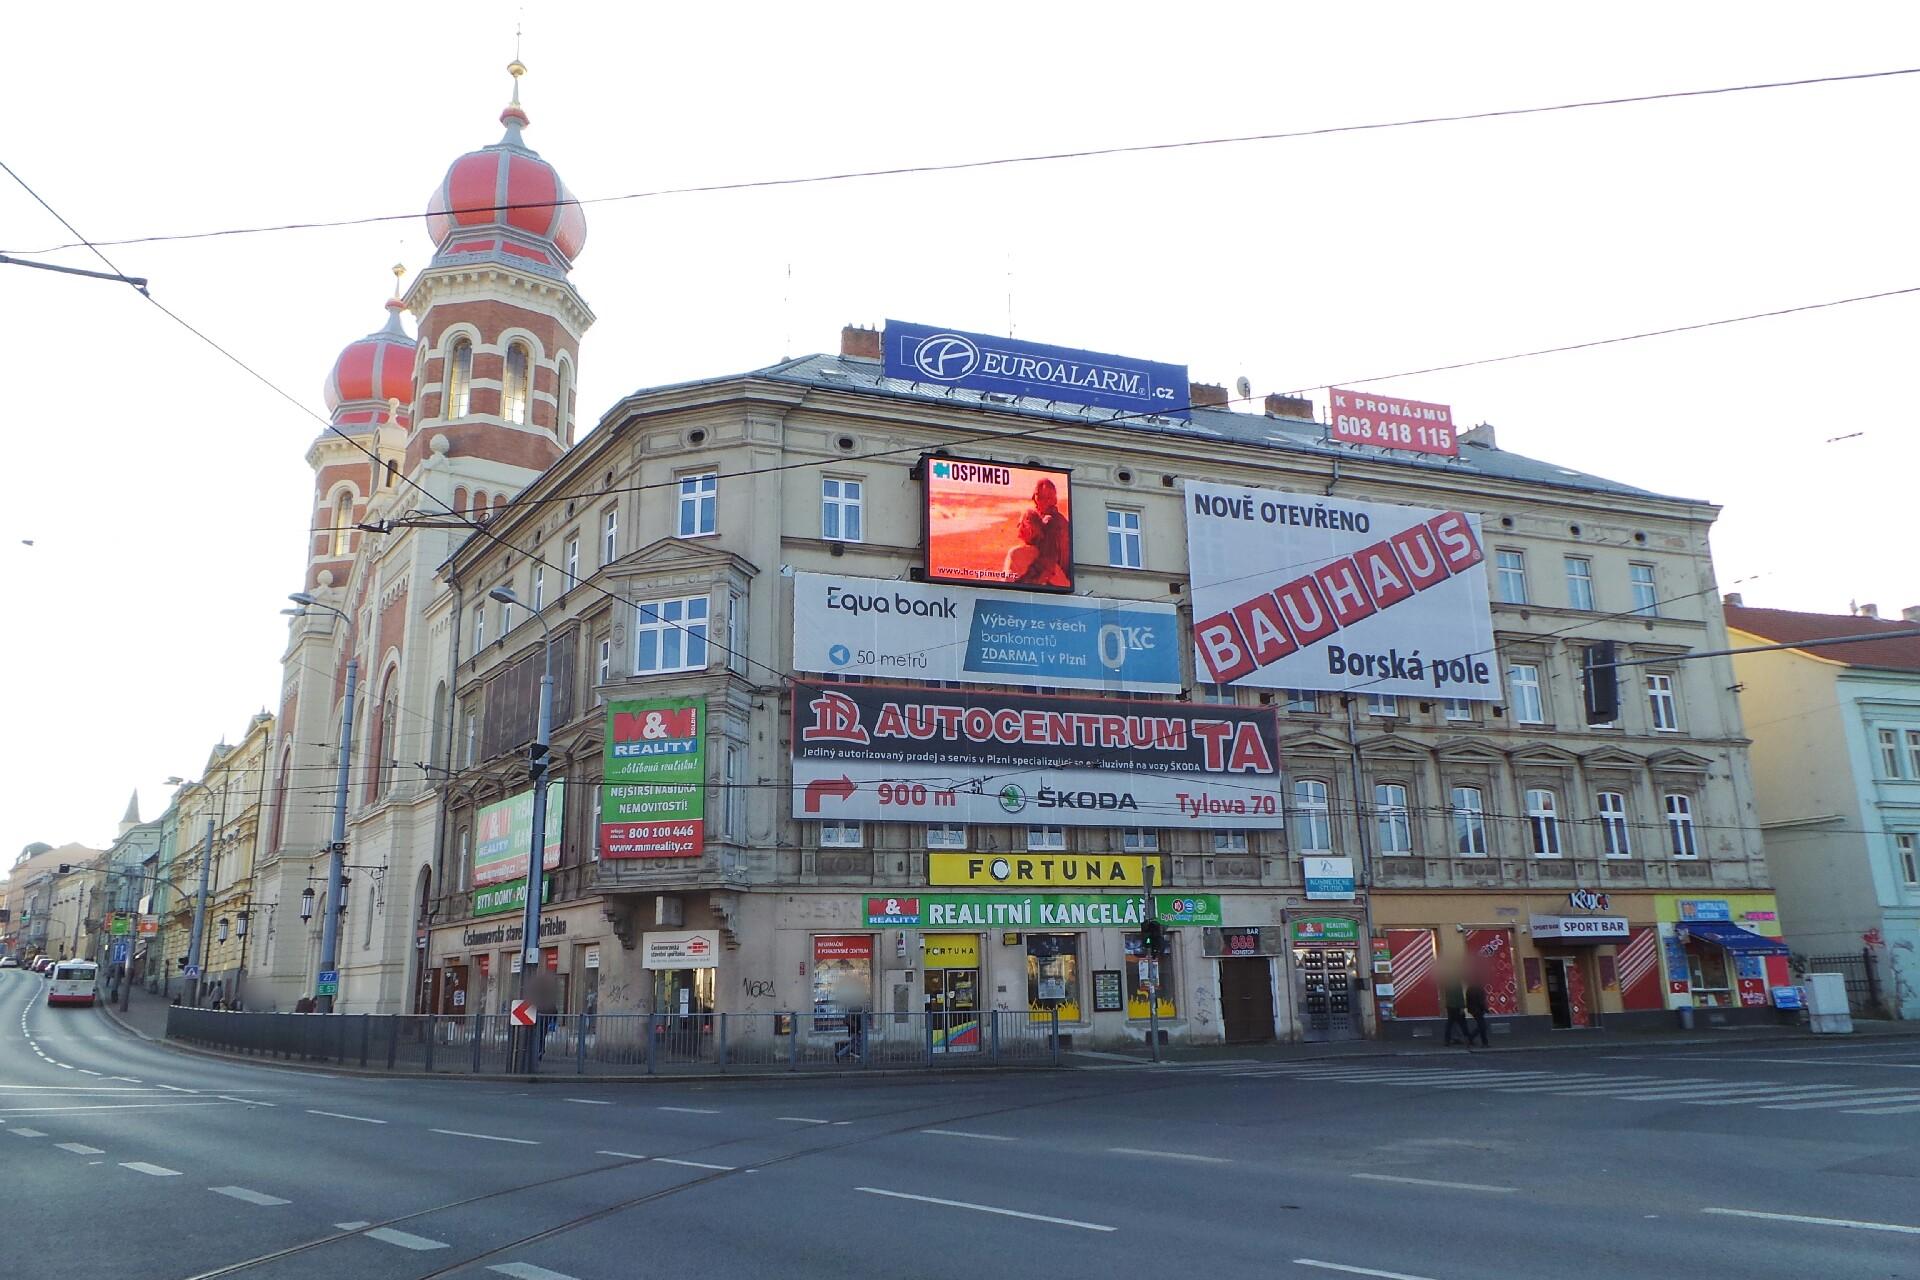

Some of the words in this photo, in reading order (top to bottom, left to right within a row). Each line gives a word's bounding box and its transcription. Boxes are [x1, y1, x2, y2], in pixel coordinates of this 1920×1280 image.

[983, 352, 1140, 394] EUROALARM
[1335, 395, 1346, 408] K
[1355, 399, 1448, 422] PRONÁJMU
[1337, 414, 1372, 438] 603
[1377, 421, 1412, 444] 418
[1417, 426, 1451, 449] 115
[1194, 493, 1255, 521] NOVĚ
[1261, 503, 1370, 534] OTEVŘENO
[827, 586, 890, 617] Equa
[895, 592, 958, 619] bank
[1200, 519, 1472, 673] BAUHAUS
[980, 612, 1028, 631] Výběry
[1031, 619, 1046, 630] ze
[1049, 618, 1087, 633] všech
[981, 630, 1057, 648] bankomatů
[1097, 623, 1126, 669] 0
[1128, 627, 1156, 650] Kč
[856, 650, 876, 665] 50
[880, 652, 928, 669] metrů
[981, 647, 1038, 663] ZDARMA
[1048, 655, 1056, 664] v
[1327, 645, 1425, 681] Borská
[1432, 654, 1490, 689] pole
[614, 740, 694, 756] REALITY
[874, 702, 1188, 751] AUTOCENTRUM
[1192, 718, 1274, 774] TA
[802, 747, 836, 759] Jediný
[838, 749, 904, 762] autorizovaný
[906, 752, 938, 764] prodej
[940, 755, 946, 763] a
[948, 753, 977, 764] servis
[979, 755, 986, 764] v
[1136, 761, 1147, 770] na
[1149, 761, 1169, 773] vozy
[1170, 760, 1200, 772] ŠKODA
[619, 799, 689, 814] NEMOVITOSTÍ!
[877, 783, 927, 806] 900
[934, 789, 956, 807] m
[1037, 787, 1138, 810] ŠKODA
[1175, 792, 1246, 819] Tylova
[1250, 795, 1276, 815] 70
[628, 828, 650, 839] 800
[652, 827, 671, 838] 100
[672, 825, 694, 837] 446
[609, 840, 694, 853] www.mmreality.cz
[968, 857, 1126, 881] FORTUNA
[477, 892, 491, 910] BYTY
[494, 888, 513, 906] DOMY
[869, 916, 918, 924] REALITY
[929, 898, 1031, 925] REALITNÍ
[1563, 921, 1599, 932] SPORT
[1601, 921, 1625, 932] BAR
[323, 973, 333, 981] 27
